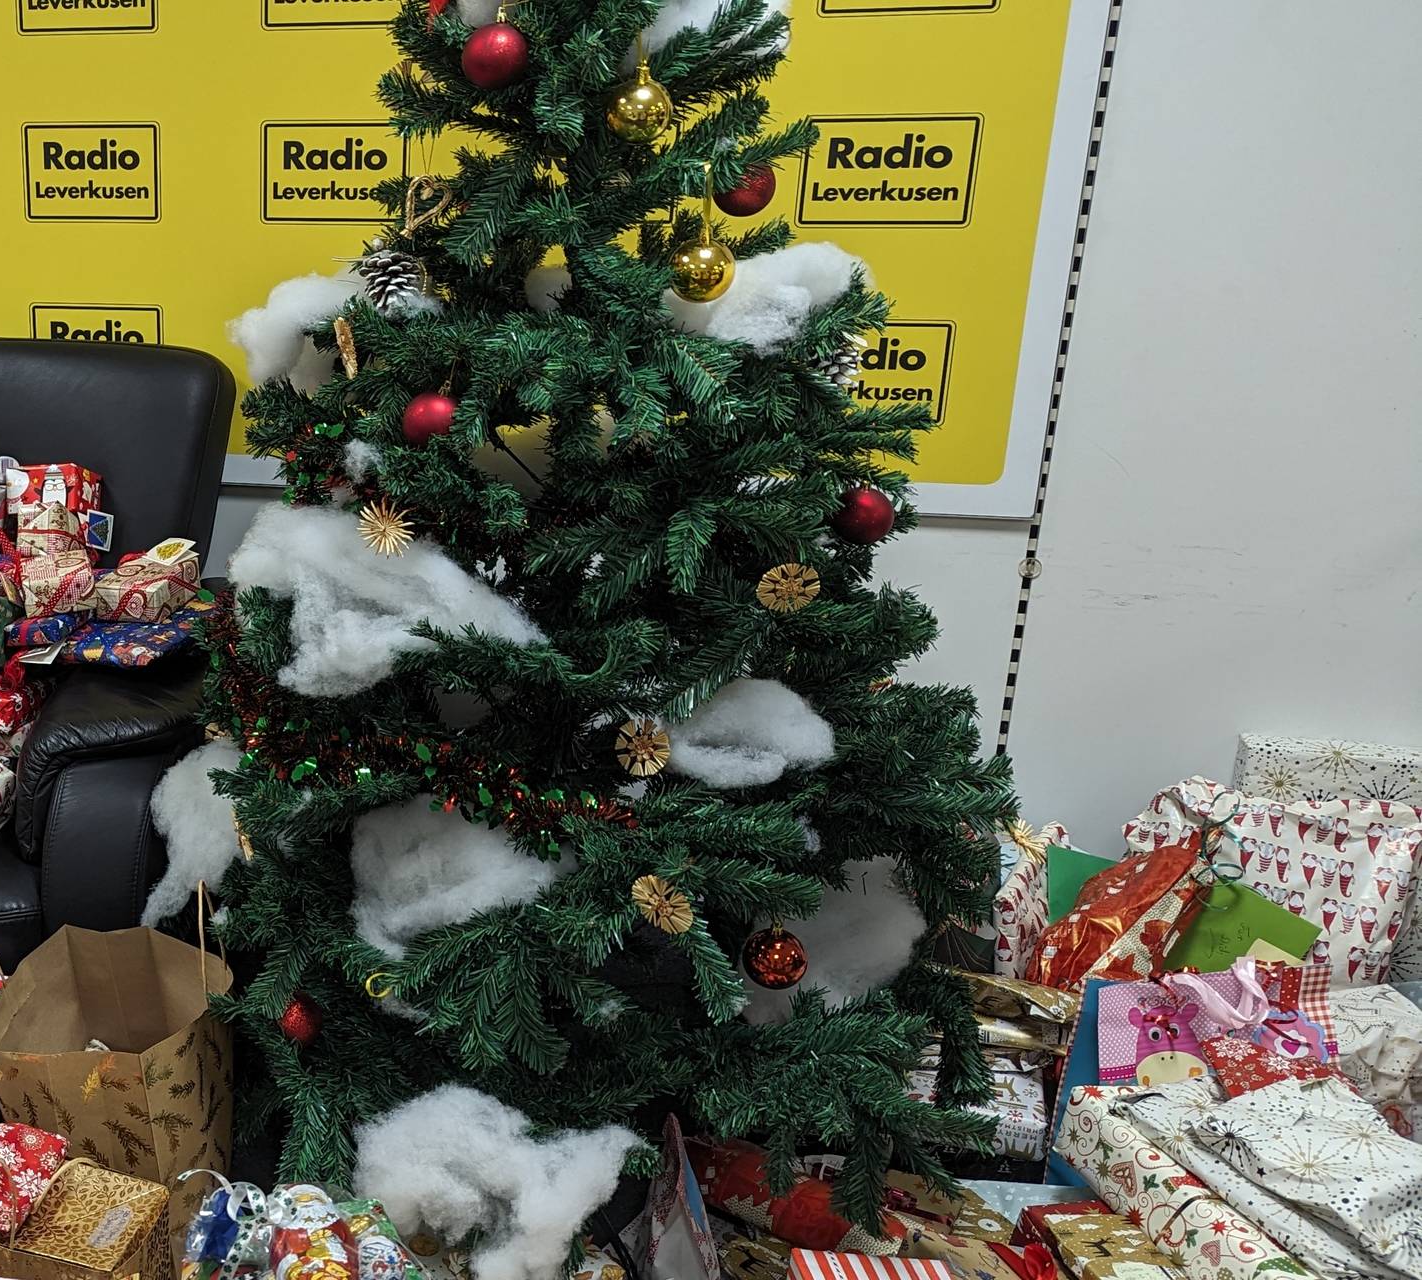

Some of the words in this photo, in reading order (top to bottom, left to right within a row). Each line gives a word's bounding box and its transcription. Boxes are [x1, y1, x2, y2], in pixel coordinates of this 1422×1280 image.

[42, 138, 140, 171] Radio
[283, 137, 388, 171] Radio
[826, 133, 953, 170] Radio
[35, 181, 149, 200] Leverkusen
[272, 180, 382, 201] Leverkuse
[811, 179, 959, 202] Leverkusen
[859, 337, 927, 371] dio
[847, 380, 934, 401] rkusen
[996, 1128, 1038, 1141] MERRY
[998, 1122, 1044, 1135] CHRISTMA
